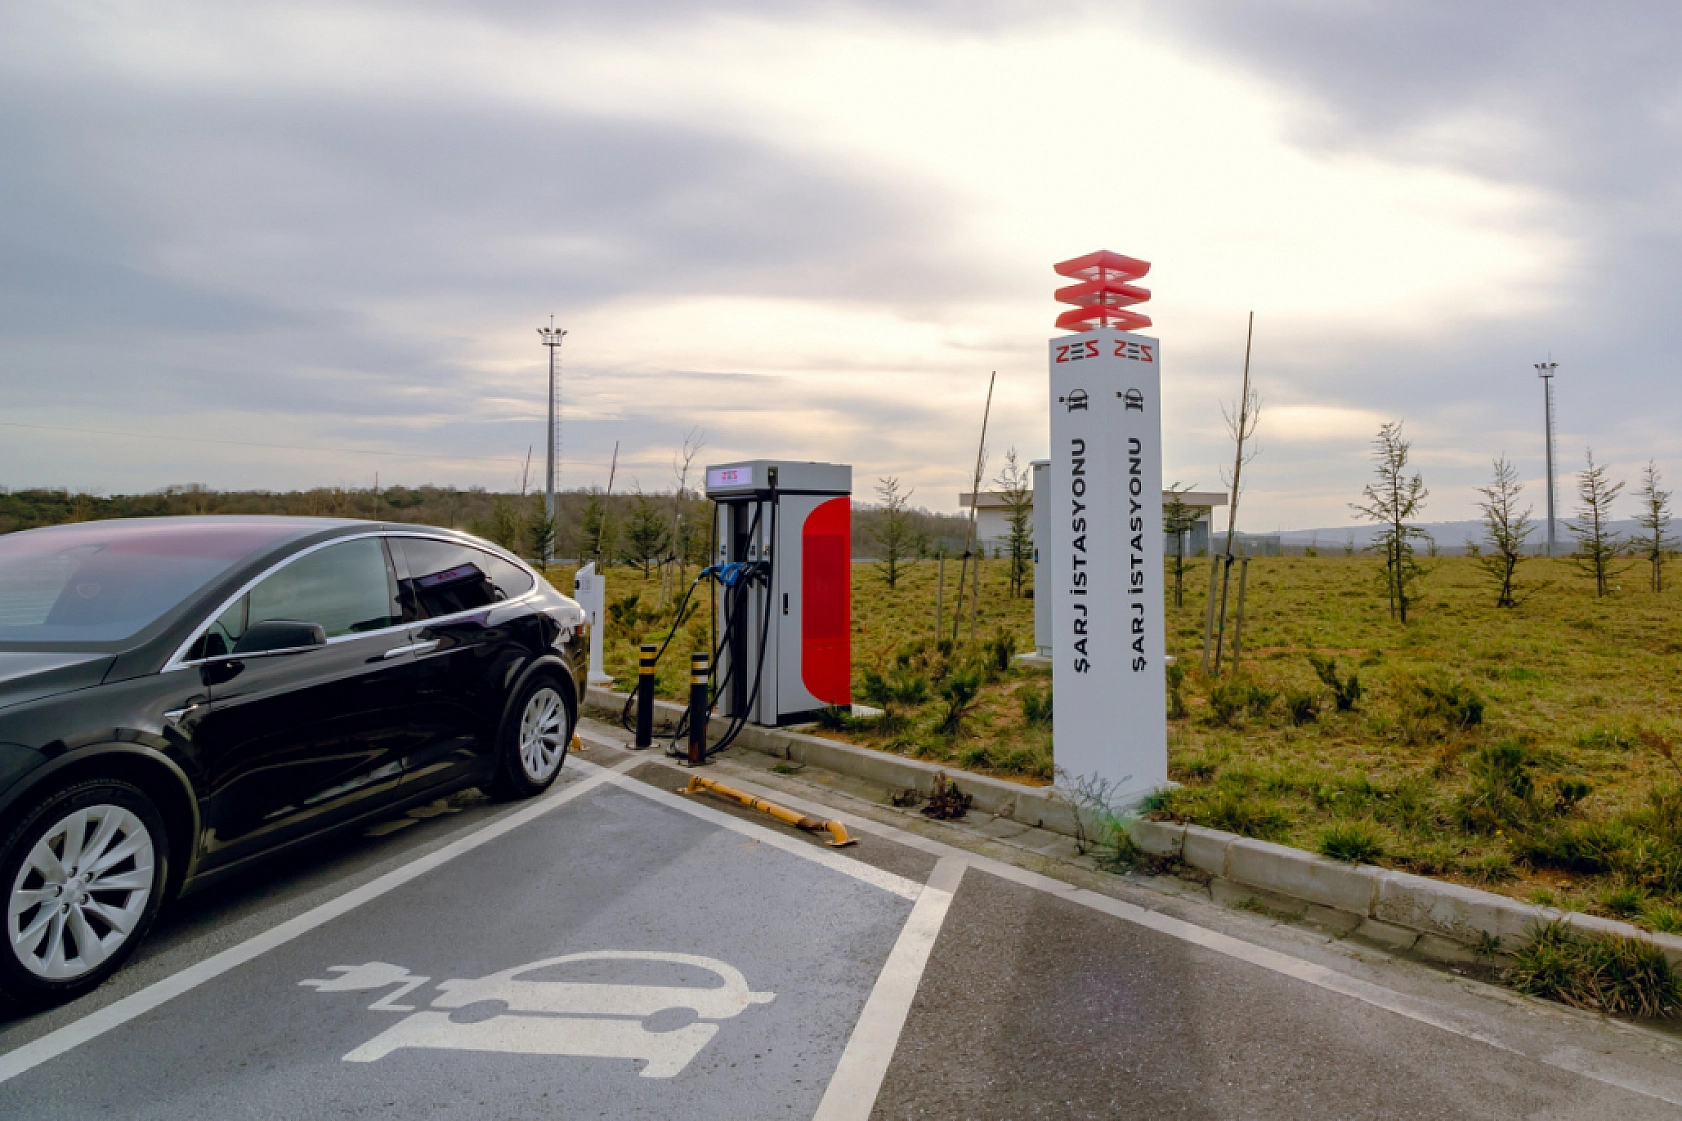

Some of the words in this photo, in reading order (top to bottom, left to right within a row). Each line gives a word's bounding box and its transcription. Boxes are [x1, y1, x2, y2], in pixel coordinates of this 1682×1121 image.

[1056, 340, 1099, 363] ZES
[1114, 340, 1152, 363] ZES
[1069, 438, 1087, 595] İSTASYONU
[1128, 438, 1143, 594] İSTASYONU
[1074, 604, 1090, 673] ŞARJ
[1131, 603, 1147, 672] ŞARJ
